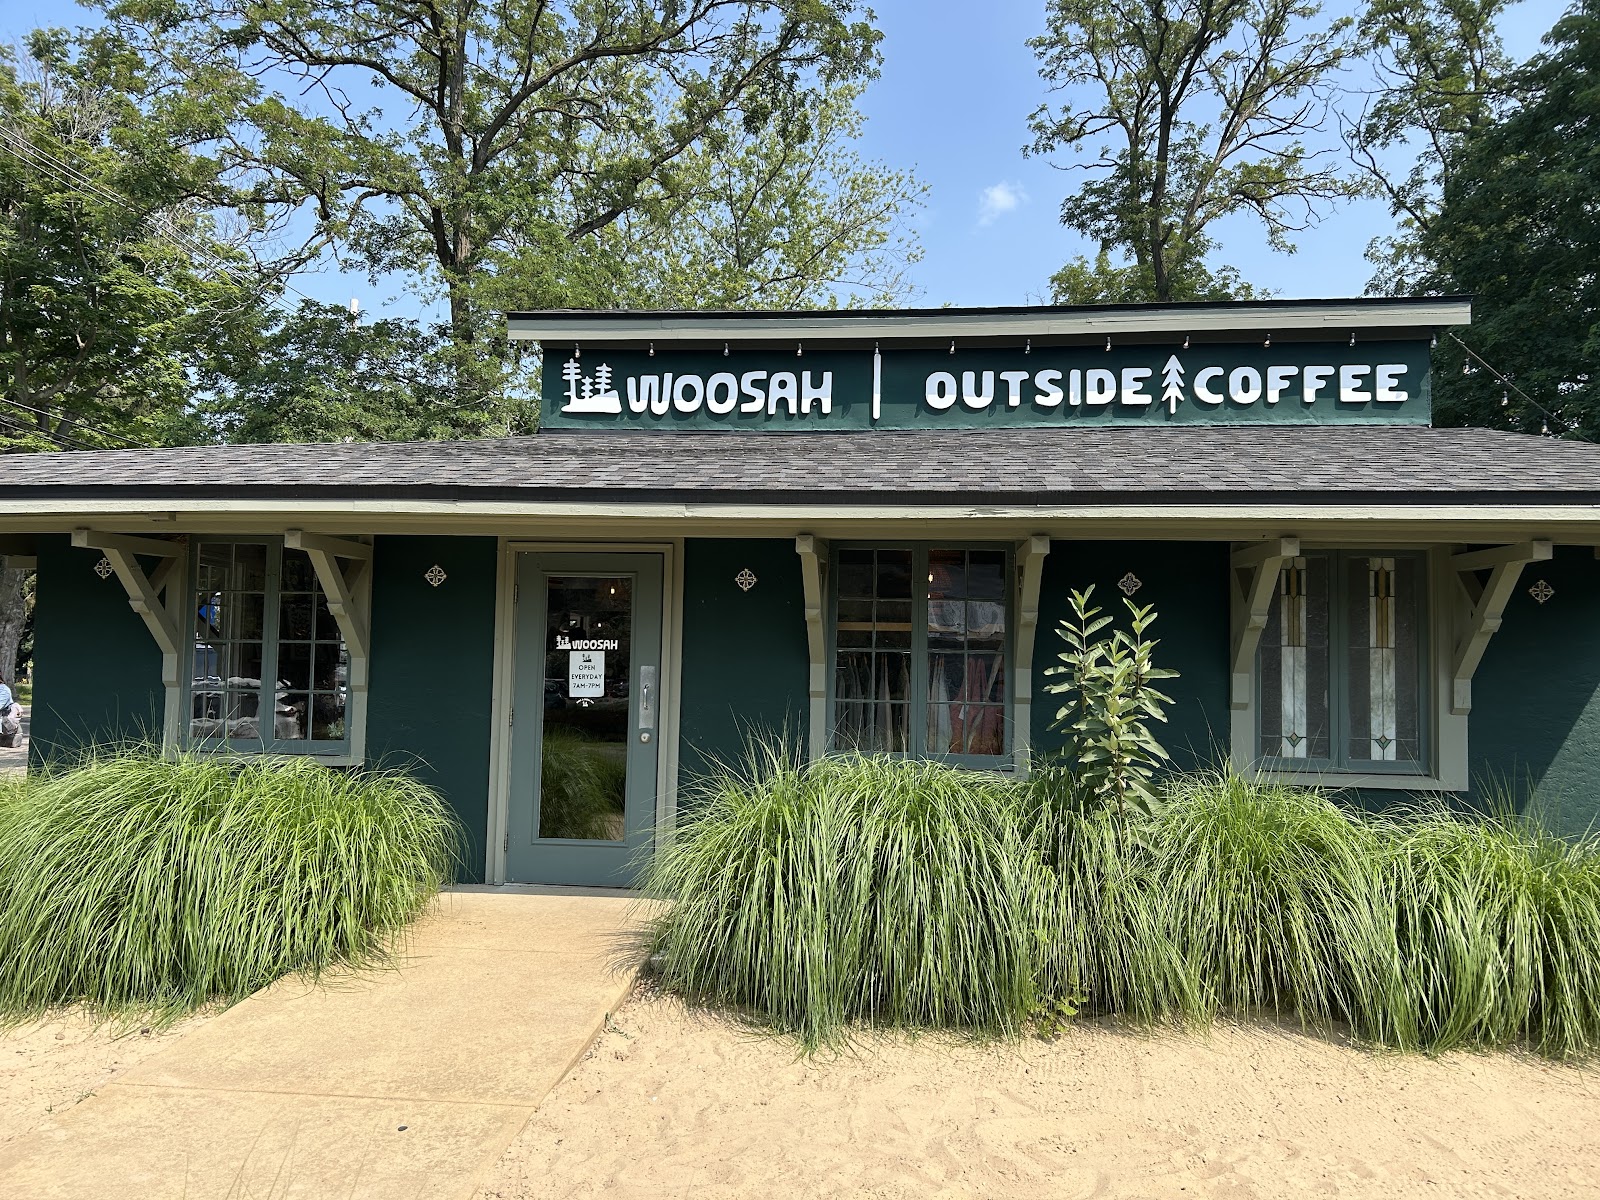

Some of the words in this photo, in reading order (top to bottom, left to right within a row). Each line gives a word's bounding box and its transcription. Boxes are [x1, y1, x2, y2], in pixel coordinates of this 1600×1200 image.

[626, 371, 832, 415] WOOSAH
[925, 368, 1153, 409] OUTSIDE
[1193, 364, 1408, 404] COFFEE
[572, 639, 618, 650] WOOSAH
